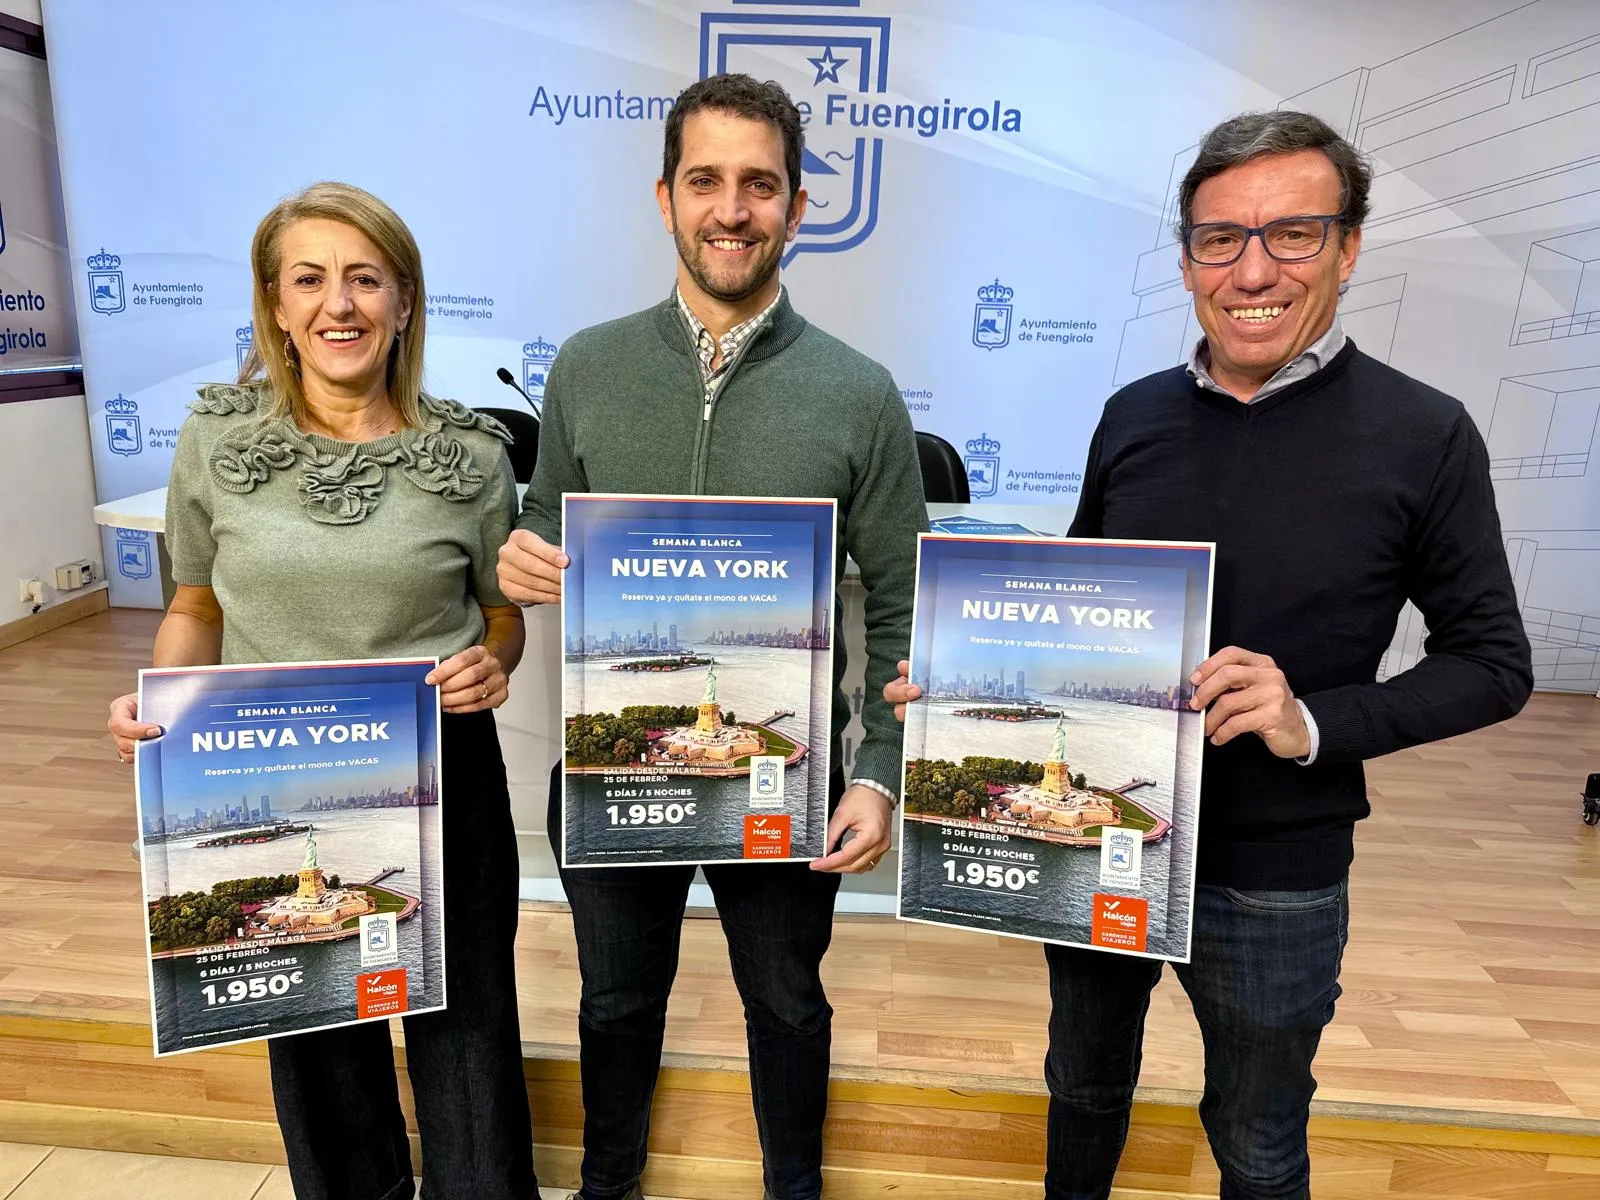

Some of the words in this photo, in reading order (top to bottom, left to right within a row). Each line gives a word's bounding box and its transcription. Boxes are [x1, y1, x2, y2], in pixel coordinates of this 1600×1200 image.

[528, 85, 684, 126] Ayuntam
[796, 100, 813, 125] e
[825, 94, 1022, 138] Fuengirola
[132, 282, 204, 294] Ayuntamiento
[133, 295, 147, 305] de
[149, 295, 203, 307] Fuengirola
[438, 306, 493, 320] Fuengirola
[1019, 318, 1097, 331] Ayuntamiento
[1018, 331, 1033, 341] de
[1036, 332, 1094, 345] Fuengirola
[149, 439, 163, 448] de
[1006, 469, 1082, 481] Ayuntamiento
[1005, 481, 1020, 491] de
[1023, 482, 1078, 495] Fuengirola
[652, 538, 697, 547] SEMANA
[700, 539, 742, 547] BLANCA
[611, 557, 707, 578] NUEVA
[713, 559, 789, 579] YORK
[1004, 580, 1051, 591] SEMANA
[1055, 583, 1102, 593] BLANCA
[621, 593, 654, 601] Reserva
[655, 595, 666, 603] ya
[667, 595, 673, 603] y
[704, 594, 712, 602] el
[737, 594, 748, 602] de
[749, 594, 778, 602] VACAS
[962, 599, 1061, 624] NUEVA
[1068, 605, 1155, 630] YORK
[969, 635, 1003, 645] Reserva
[1004, 638, 1015, 647] ya
[1016, 639, 1023, 648] y
[1056, 641, 1065, 649] el
[1066, 643, 1092, 651] mono
[1093, 643, 1105, 652] de
[1107, 645, 1140, 654] VACAS
[236, 706, 286, 717] SEMANA
[290, 704, 337, 715] BLANCA
[191, 727, 299, 753] NUEVA
[306, 721, 391, 745] YORK
[204, 768, 241, 776] Reserva
[243, 767, 254, 776] ya
[256, 766, 262, 774] y
[298, 762, 306, 770] el
[308, 761, 333, 769] mono
[335, 759, 346, 767] de
[348, 757, 380, 766] VACAS
[603, 767, 635, 775] SALIDA
[636, 767, 664, 775] DESDE
[666, 766, 702, 774] MÁLAGA
[629, 775, 669, 783] FEBRERO
[614, 788, 637, 797] DÍAS
[638, 789, 644, 797] /
[654, 788, 692, 796] NOCHES
[606, 802, 697, 825] 1.950€
[942, 819, 974, 829] SALIDA
[976, 823, 1005, 833] DESDE
[1007, 826, 1046, 838] MÁLAGA
[954, 829, 966, 837] DE
[968, 830, 1009, 842] FEBRERO
[943, 842, 950, 850] 6
[952, 842, 976, 854] DÍAS
[977, 846, 983, 855] /
[985, 848, 992, 856] 5
[993, 848, 1035, 861] NOCHES
[942, 859, 1040, 891] 1.950€
[1102, 911, 1137, 922] Halcón
[195, 944, 232, 955] SALIDA
[233, 940, 265, 950] DESDE
[267, 934, 306, 946] MÁLAGA
[1101, 936, 1137, 946] VIAJEROS
[196, 955, 208, 964] 25
[210, 953, 224, 961] DE
[226, 947, 270, 960] FEBRERO
[199, 969, 208, 978] 6
[209, 965, 236, 977] DÍAS
[237, 964, 244, 973] /
[245, 963, 253, 971] 5
[254, 957, 298, 970] NOCHES
[201, 970, 304, 1006] 1.950€
[366, 983, 398, 994] Halcón
[367, 1004, 399, 1014] VIAJEROS
